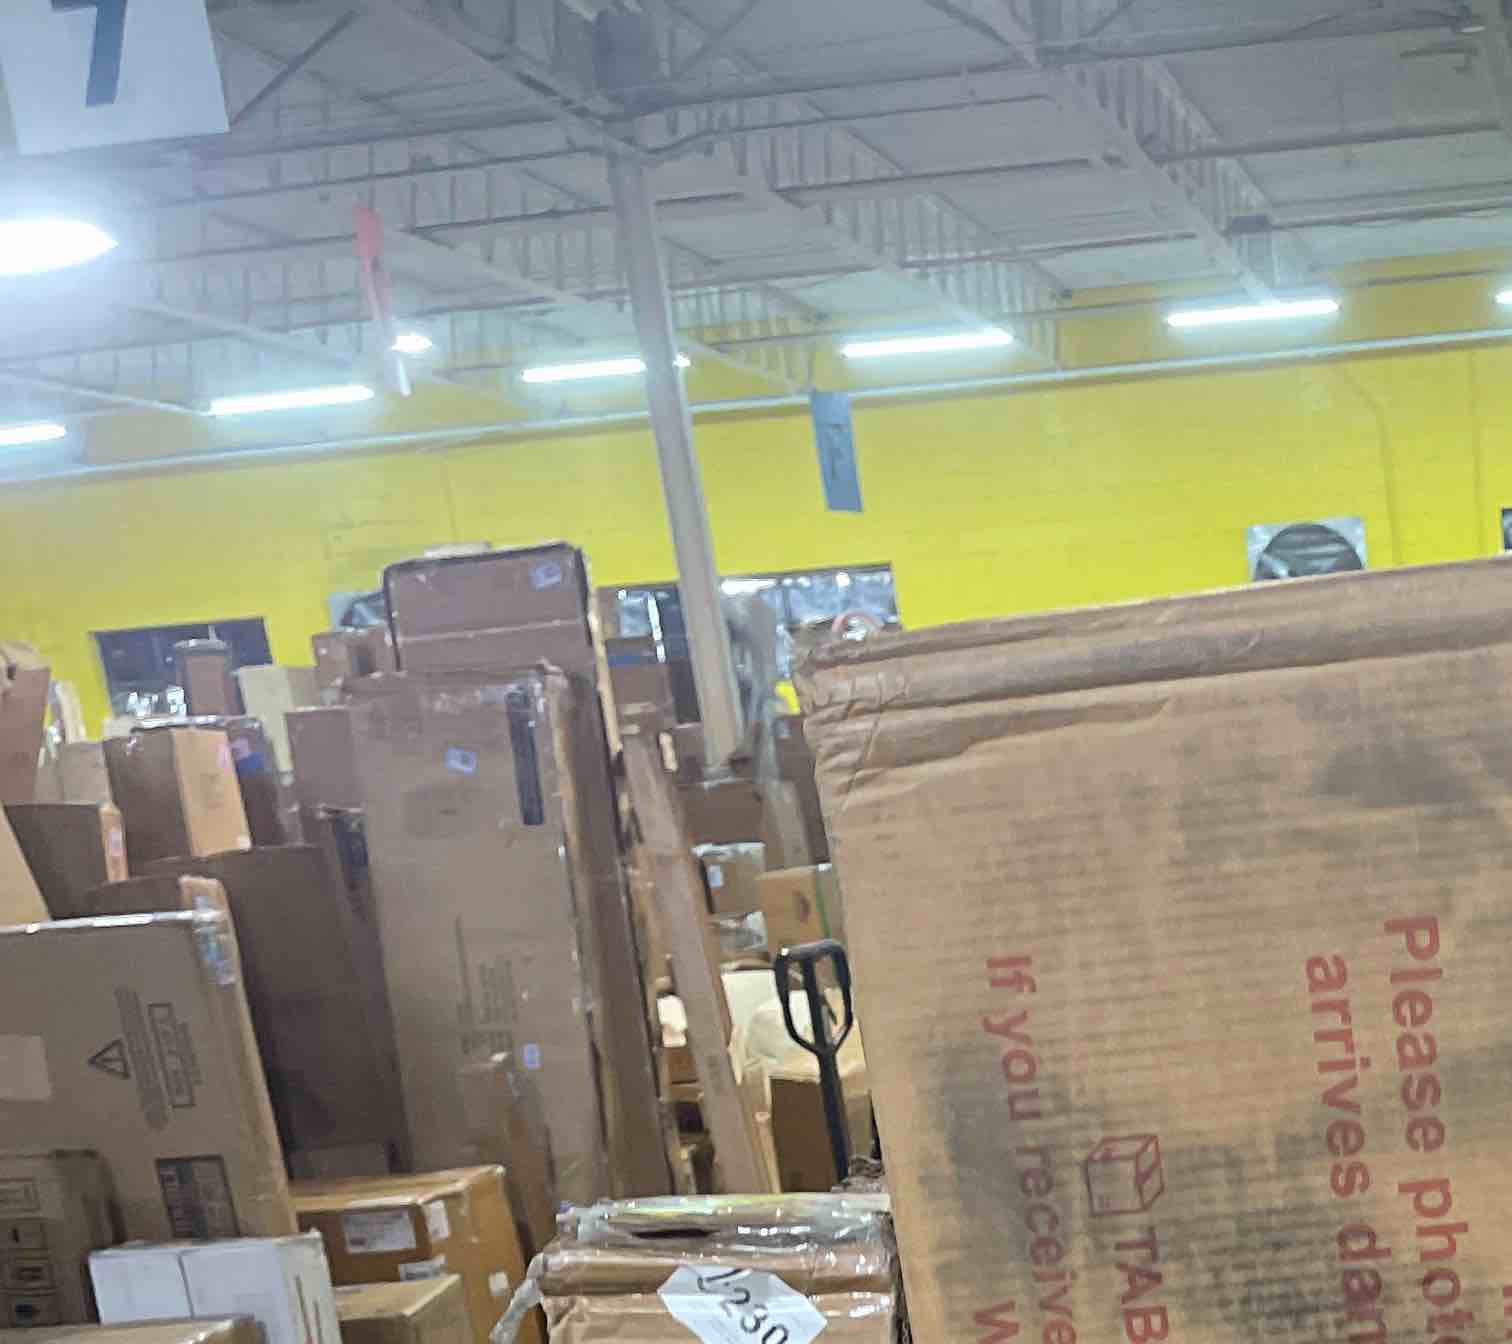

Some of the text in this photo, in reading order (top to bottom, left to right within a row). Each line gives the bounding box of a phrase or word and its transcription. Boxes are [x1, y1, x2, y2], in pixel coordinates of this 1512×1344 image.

[985, 956, 1037, 994] If
[1384, 914, 1449, 1153] Please
[982, 1010, 1042, 1121] you
[1305, 954, 1373, 1198] arrives
